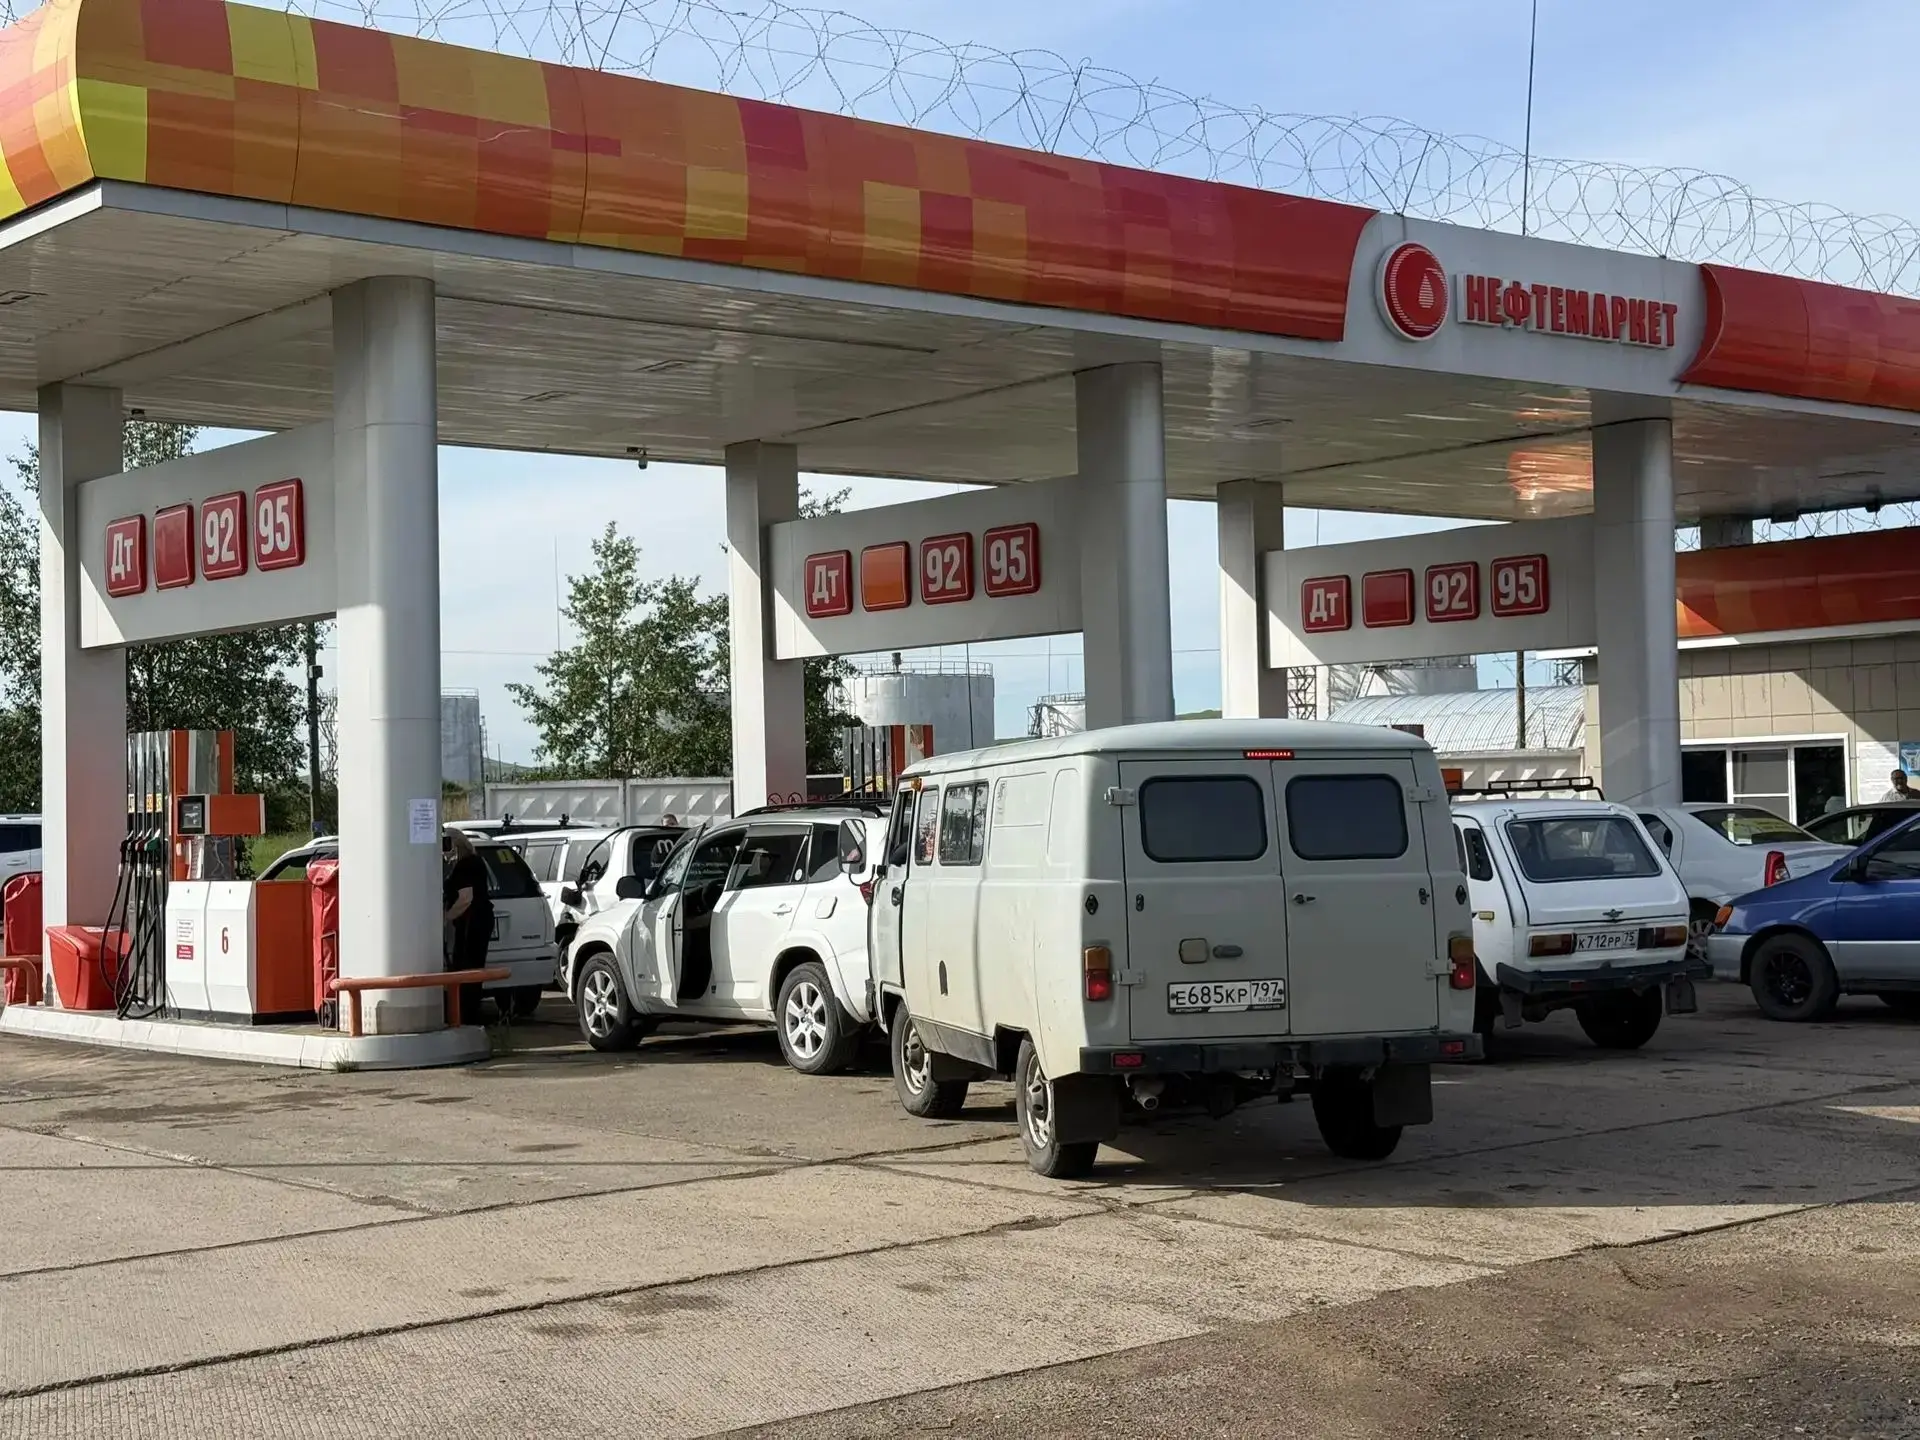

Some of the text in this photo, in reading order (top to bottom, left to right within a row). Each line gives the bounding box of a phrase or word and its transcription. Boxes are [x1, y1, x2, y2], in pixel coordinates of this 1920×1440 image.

[1465, 274, 1678, 347] НЕФТЕМАРКЕТ
[204, 507, 235, 564] 92
[258, 495, 291, 555] 95
[926, 545, 962, 593] 92
[990, 536, 1026, 585] 95
[1431, 571, 1468, 611] 92
[1497, 564, 1536, 606] 95
[221, 926, 229, 954] 6
[1251, 981, 1279, 997] 797
